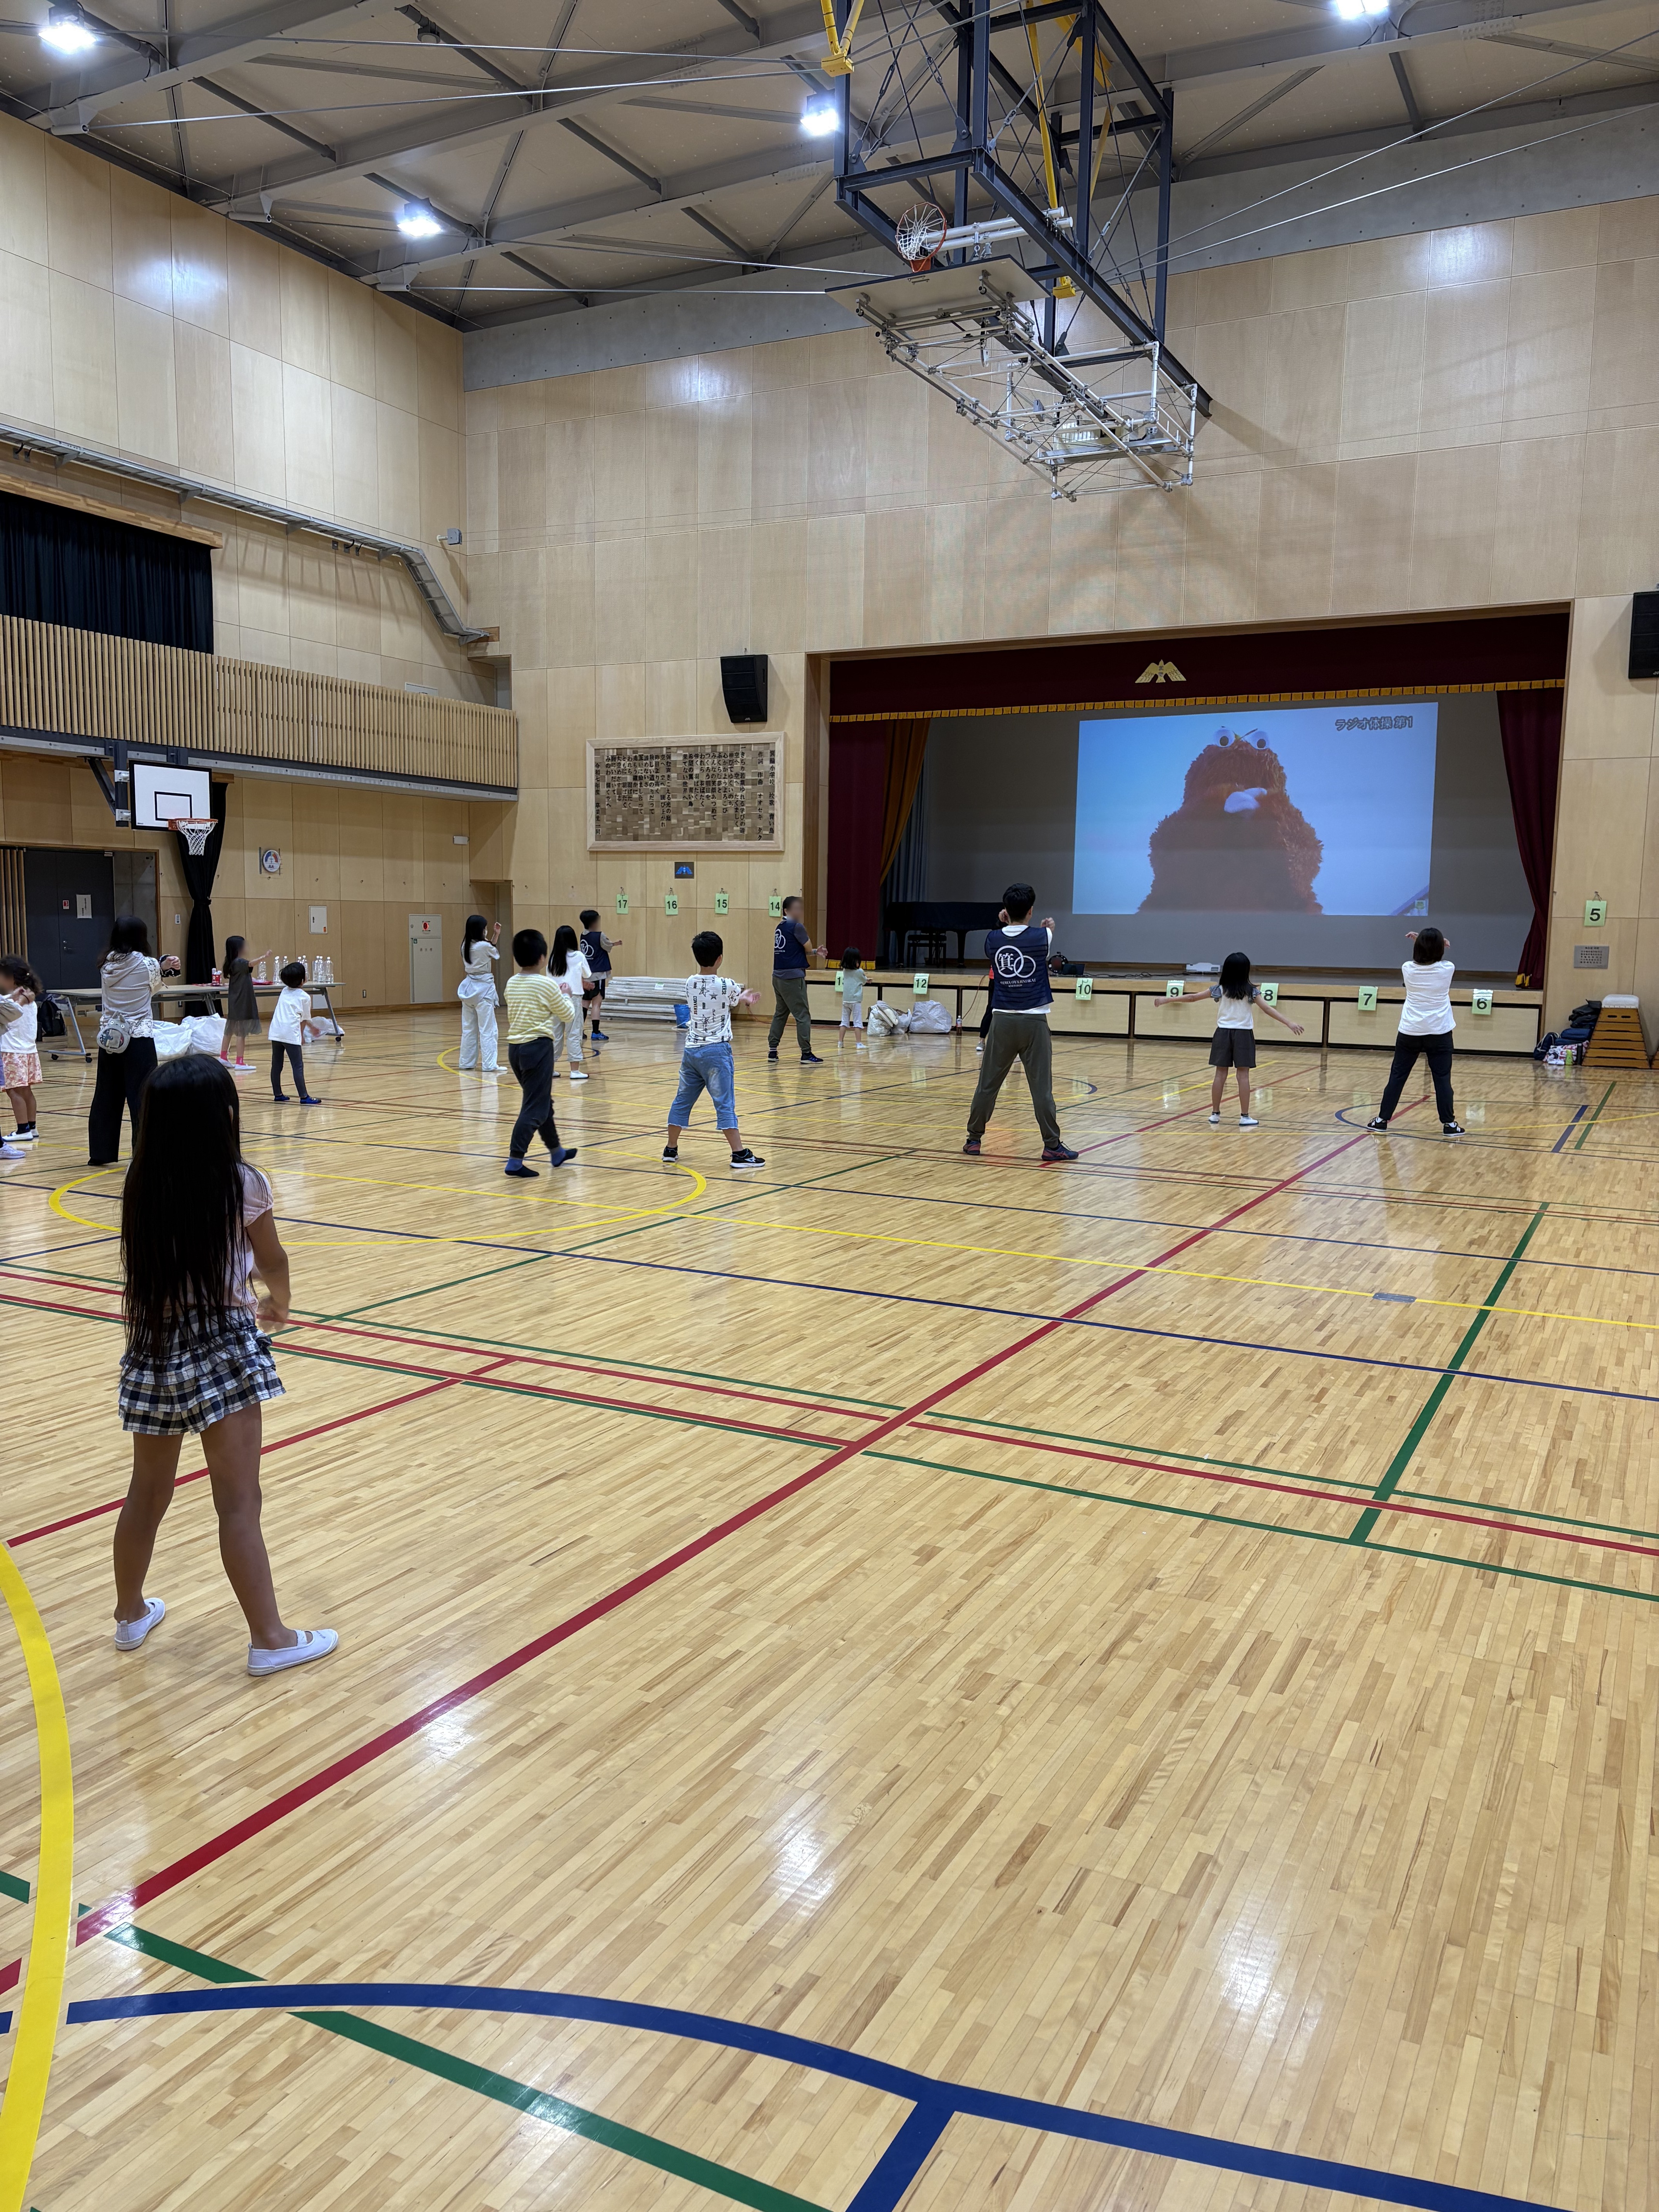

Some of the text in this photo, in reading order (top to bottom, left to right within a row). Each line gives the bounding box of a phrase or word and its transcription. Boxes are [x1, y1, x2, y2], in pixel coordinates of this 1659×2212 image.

[1335, 715, 1413, 732] ラジオ体操 第1
[661, 754, 666, 765] 空へ
[734, 752, 740, 763] 空へ
[660, 775, 666, 786] 空へ
[734, 772, 740, 784] 空へ
[618, 900, 627, 908] 17
[667, 900, 677, 909] 16
[717, 899, 727, 908] 15
[770, 902, 780, 911] 14
[1590, 908, 1601, 921] 5
[998, 953, 1014, 971] 箕
[837, 977, 844, 986] 1
[916, 979, 927, 988] 12
[1078, 984, 1091, 994] 10
[1170, 987, 1179, 997] 9
[1264, 989, 1273, 1001] 8
[1362, 993, 1372, 1006] 7
[1476, 998, 1487, 1010] 6
